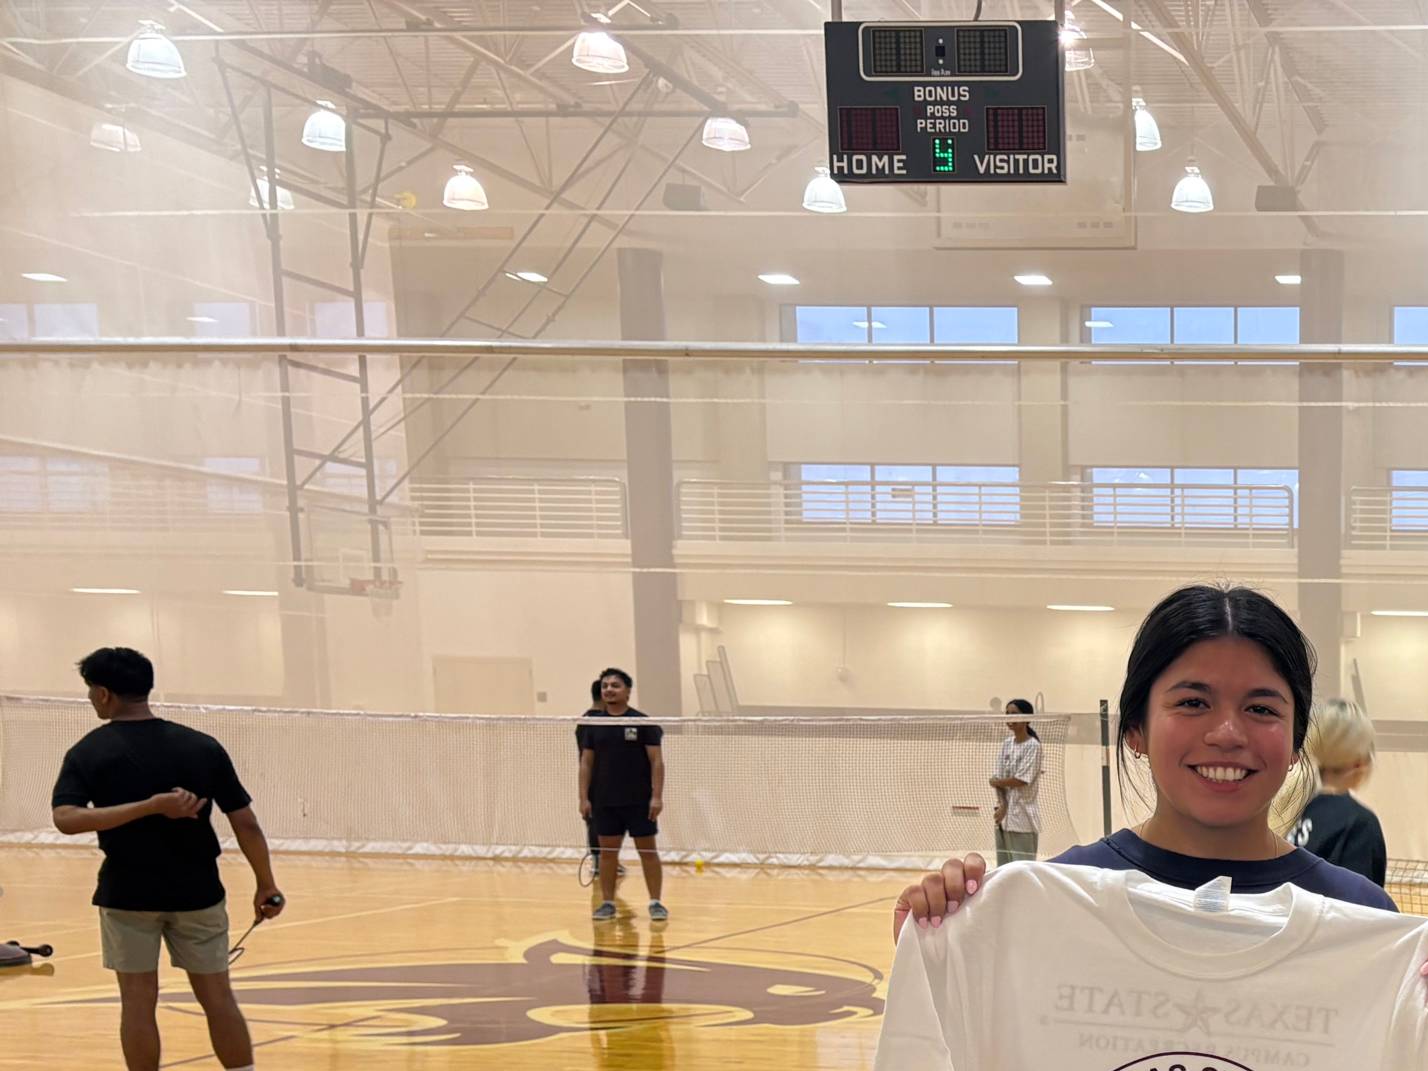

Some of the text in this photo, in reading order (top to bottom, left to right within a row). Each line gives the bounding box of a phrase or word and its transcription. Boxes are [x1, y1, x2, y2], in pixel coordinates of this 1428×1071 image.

[913, 86, 970, 102] BONUS
[926, 105, 957, 117] POSS
[916, 119, 969, 133] PERIOD
[832, 154, 908, 174] HOME
[973, 154, 1058, 175] VISITOR
